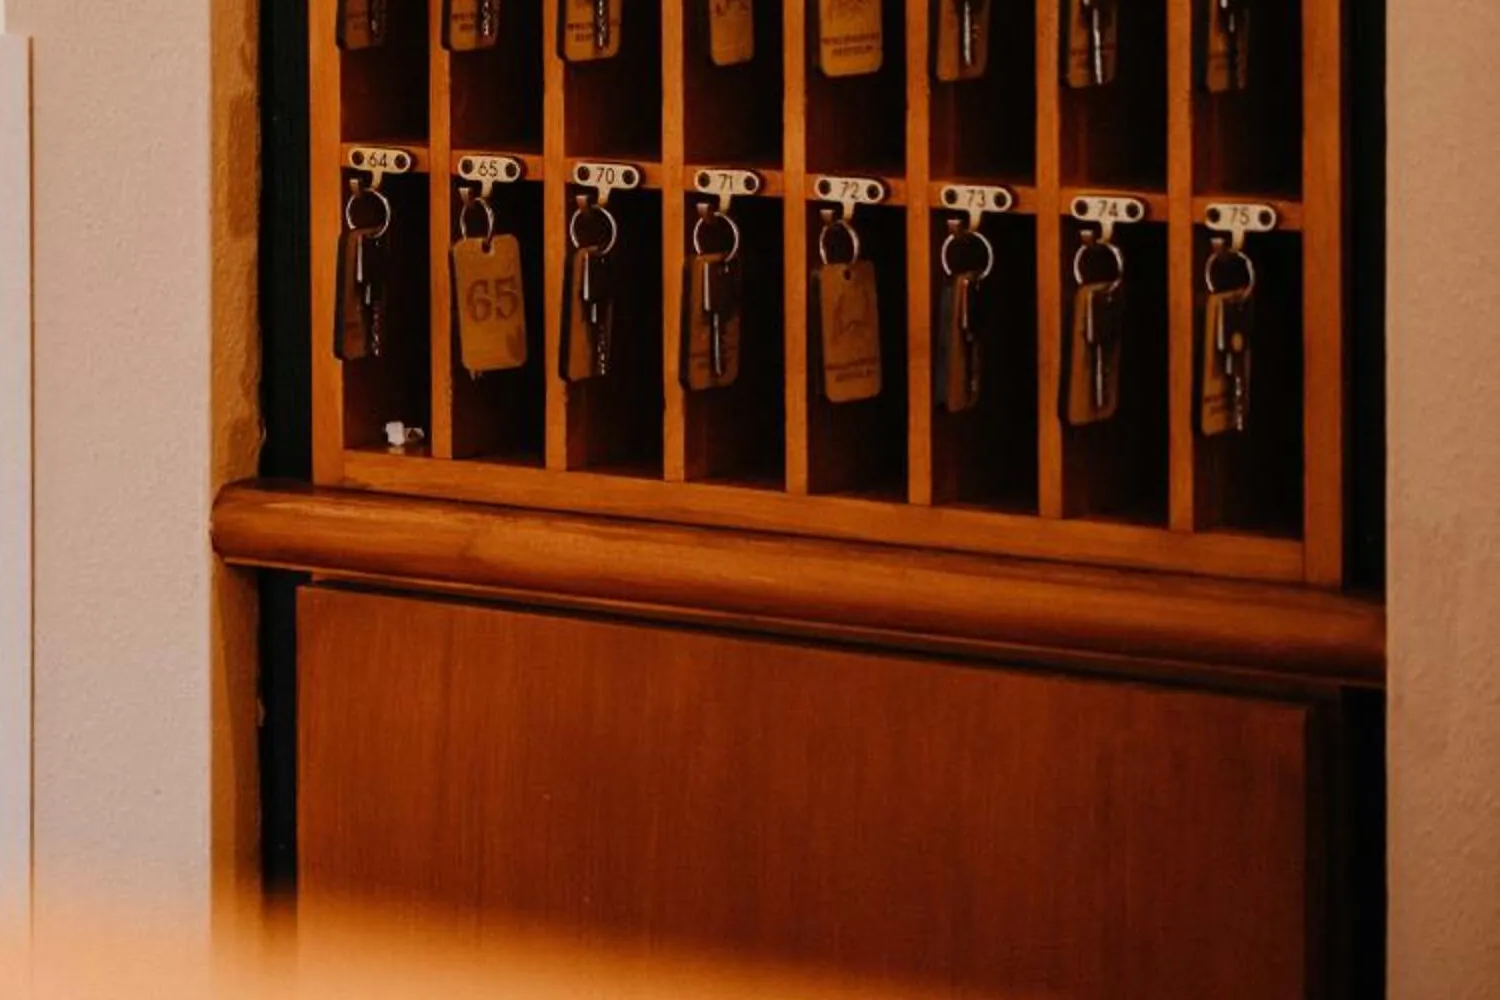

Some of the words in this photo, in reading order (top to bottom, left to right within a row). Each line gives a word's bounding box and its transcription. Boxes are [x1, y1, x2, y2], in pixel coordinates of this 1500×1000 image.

[368, 151, 388, 166] 64
[477, 161, 498, 177] 65
[595, 167, 615, 184] 70
[719, 174, 734, 191] 71
[840, 182, 859, 199] 72
[966, 190, 986, 208] 73
[1097, 200, 1119, 218] 74
[1229, 207, 1250, 226] 75
[467, 275, 517, 322] 65
